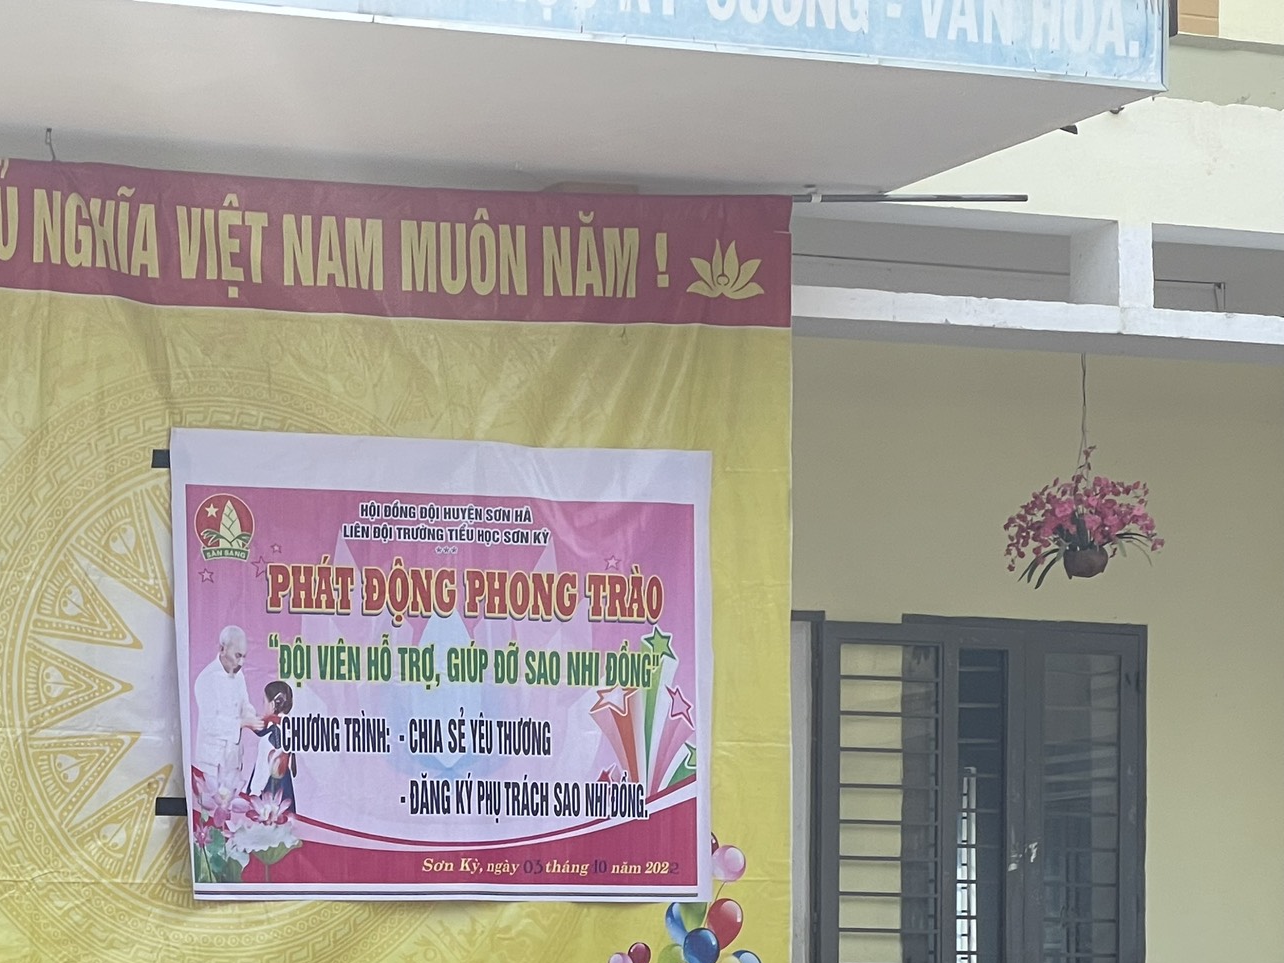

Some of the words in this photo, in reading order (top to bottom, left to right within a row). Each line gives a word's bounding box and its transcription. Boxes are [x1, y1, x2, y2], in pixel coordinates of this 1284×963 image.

[32, 185, 161, 279] NGHĨA
[176, 193, 269, 298] VIỆT
[282, 215, 384, 291] NAM
[401, 207, 529, 297] MUÔN
[542, 210, 640, 298] NĂM
[656, 231, 671, 286] !
[343, 523, 370, 539] LIÊN
[373, 524, 392, 542] ĐỘI
[396, 525, 444, 541] TRƯỜNG
[448, 523, 474, 542] TIỂU
[477, 530, 500, 545] HỌC
[503, 530, 530, 544] SƠN
[360, 502, 380, 522] HỘI
[420, 504, 440, 523] ĐỘI
[443, 504, 483, 523] HUYỆN
[485, 507, 511, 523] SƠN
[514, 506, 532, 523] HÀ
[267, 555, 355, 615] PHÁT
[362, 557, 457, 627] ĐỘNG
[464, 568, 579, 621] PHONG
[585, 564, 664, 624] TRÀO
[317, 638, 361, 681] VIÊN
[368, 634, 392, 682] HỖ
[398, 644, 440, 689] TRỢ,
[447, 641, 488, 683] GIÚP
[494, 642, 519, 684] ĐỠ
[525, 650, 561, 686] SAO
[567, 652, 600, 686] NHI
[281, 713, 340, 752] CHƯƠNG
[344, 710, 390, 753] TRÌNH:
[409, 719, 443, 753] CHIA
[448, 707, 466, 754] SẺ
[470, 713, 493, 754] YÊU
[497, 717, 551, 756] THƯƠNG
[410, 773, 450, 815] ĐĂNG
[456, 772, 473, 815] KÝ
[477, 780, 501, 823] PHỤ
[504, 775, 549, 817] TRÁCH
[553, 782, 581, 817] SAO
[585, 783, 609, 818] NHI
[611, 772, 648, 819] ĐỒNG.
[422, 858, 454, 872] Sơn
[486, 859, 520, 876] ngày
[545, 859, 589, 877] tháng
[611, 861, 641, 874] năm
